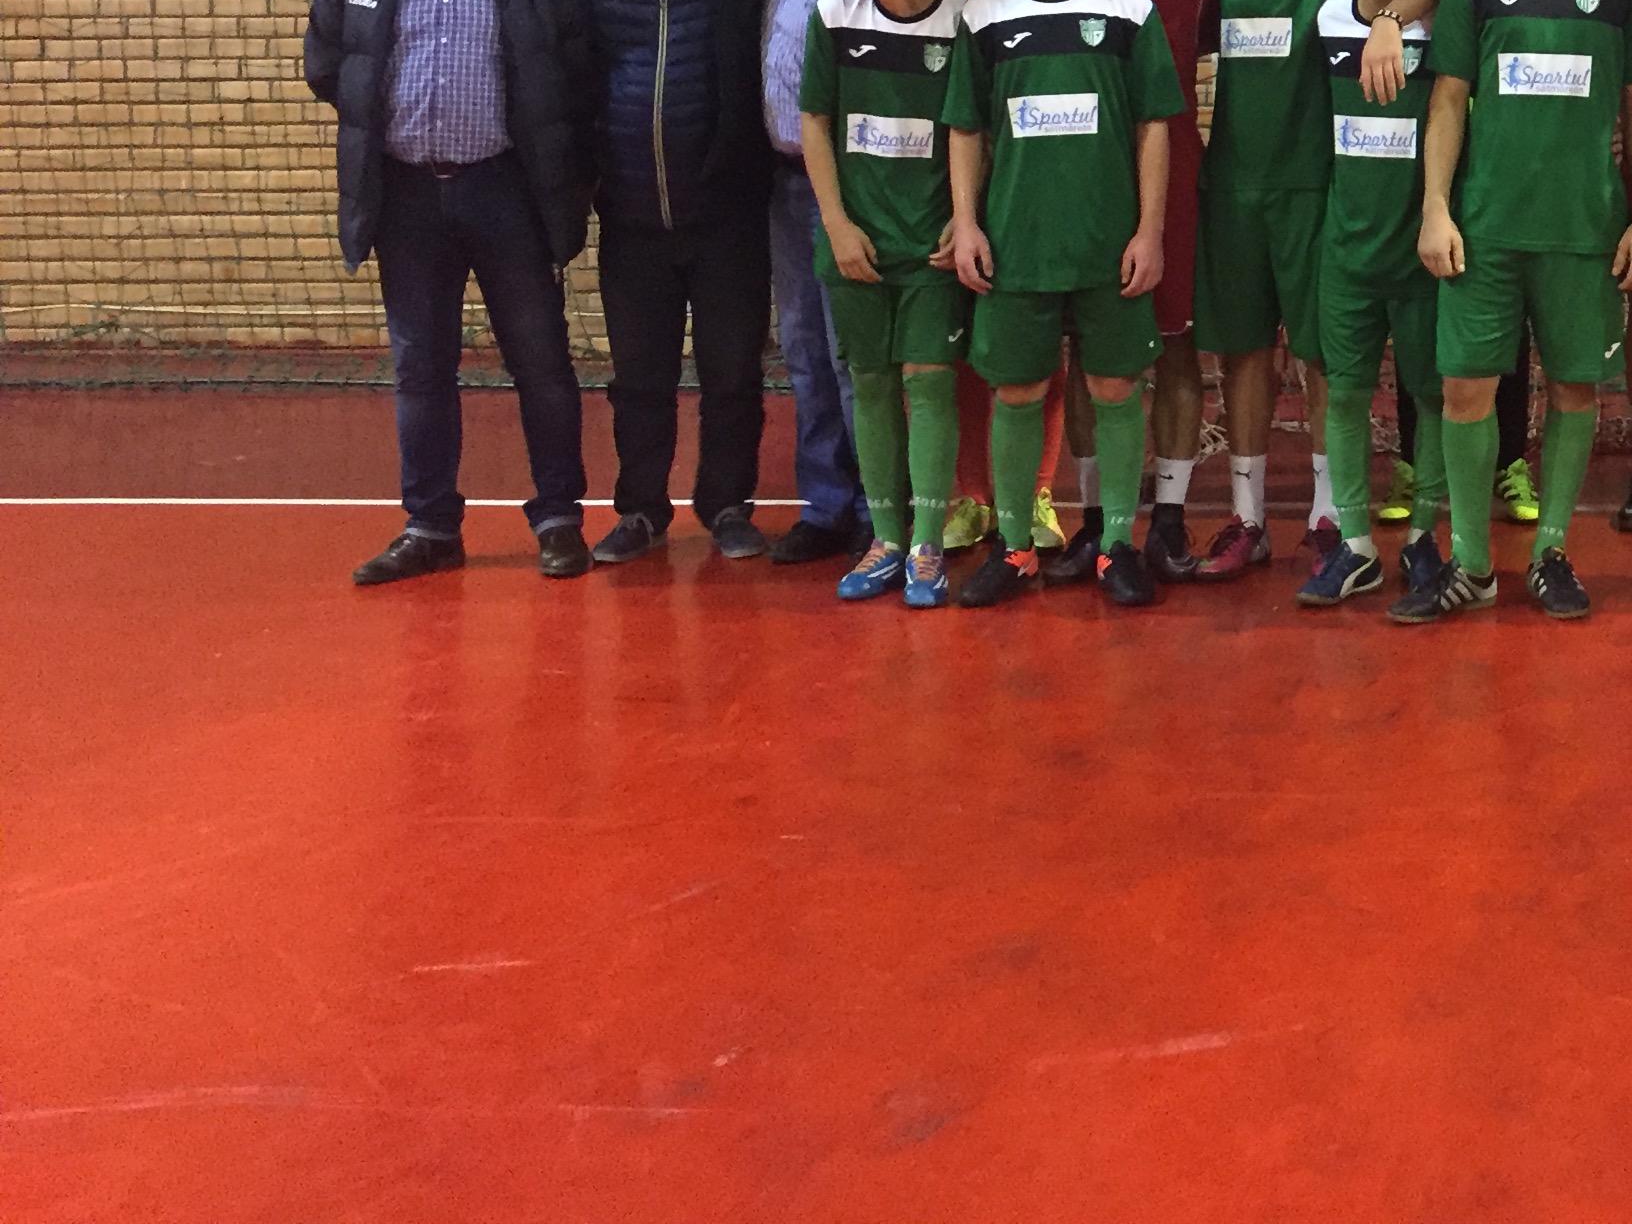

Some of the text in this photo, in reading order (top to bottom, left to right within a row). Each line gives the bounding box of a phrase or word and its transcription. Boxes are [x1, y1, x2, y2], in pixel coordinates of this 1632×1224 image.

[1520, 64, 1591, 90] Sportul
[1027, 105, 1098, 131] Sportul
[1349, 127, 1416, 149] Sportul
